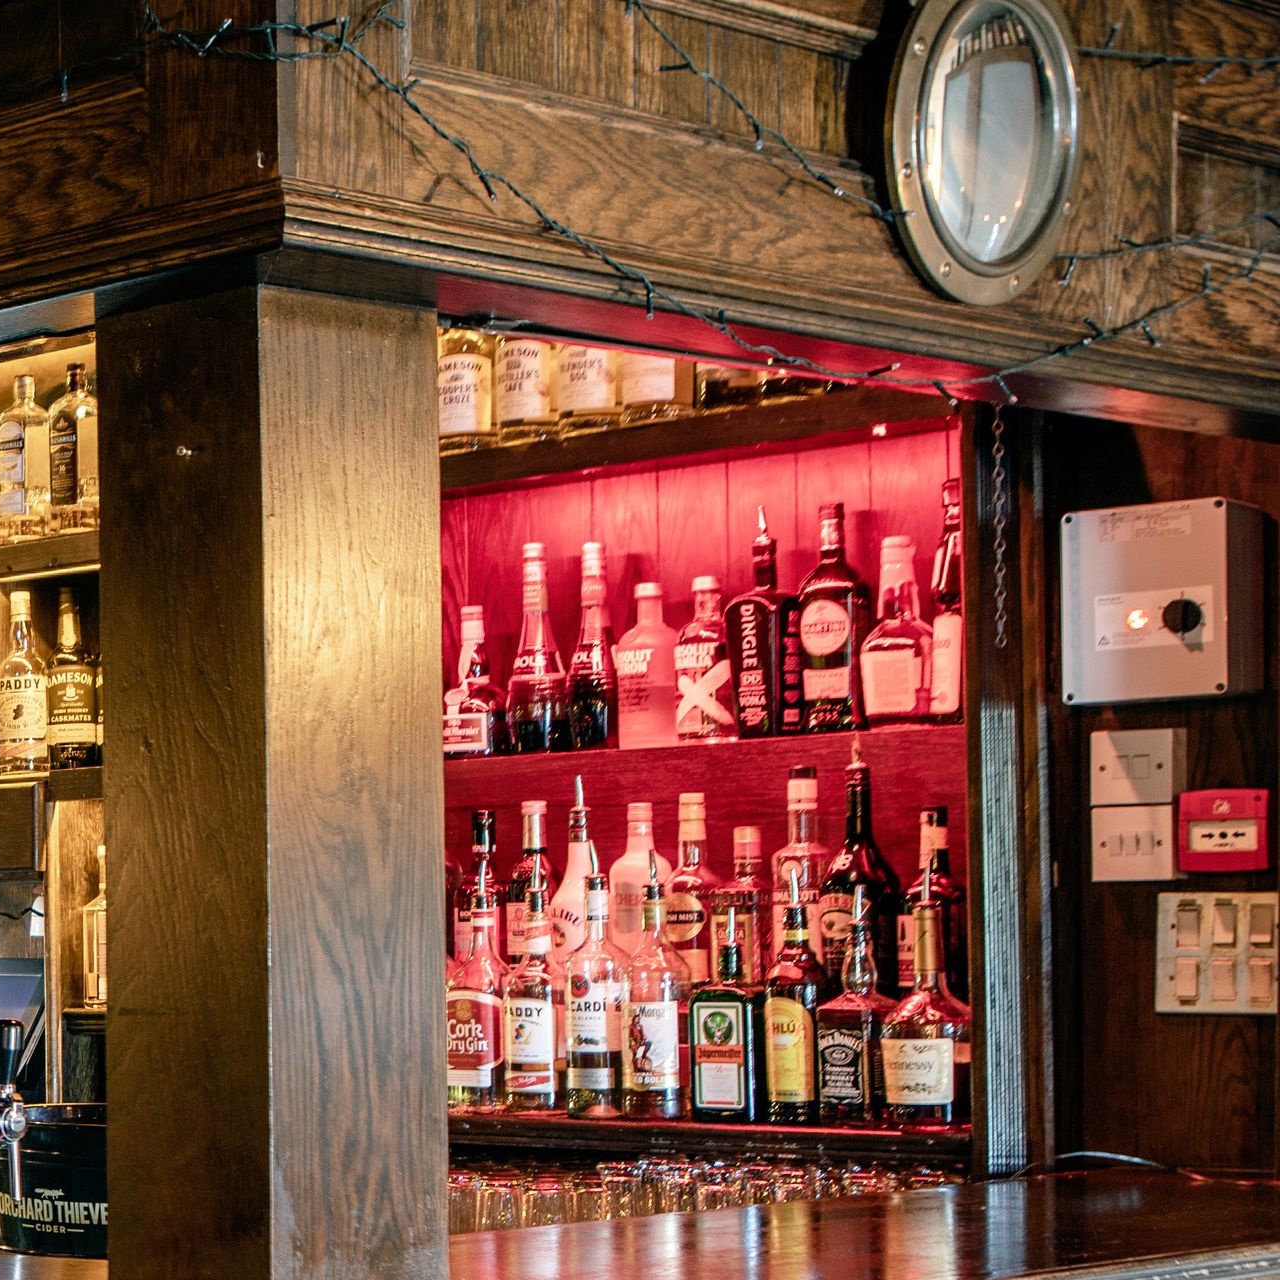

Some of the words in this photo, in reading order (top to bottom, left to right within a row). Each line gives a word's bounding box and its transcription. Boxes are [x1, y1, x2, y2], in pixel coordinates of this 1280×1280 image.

[439, 361, 482, 373] AMESON
[740, 603, 758, 668] DINGLE
[513, 654, 548, 668] BOLS
[1, 678, 40, 691] PADDY
[46, 672, 93, 688] JAMESON
[51, 714, 92, 723] CASKMATES
[447, 1019, 484, 1039] Cork
[466, 1037, 488, 1055] Gin
[35, 1223, 66, 1234] CIDER
